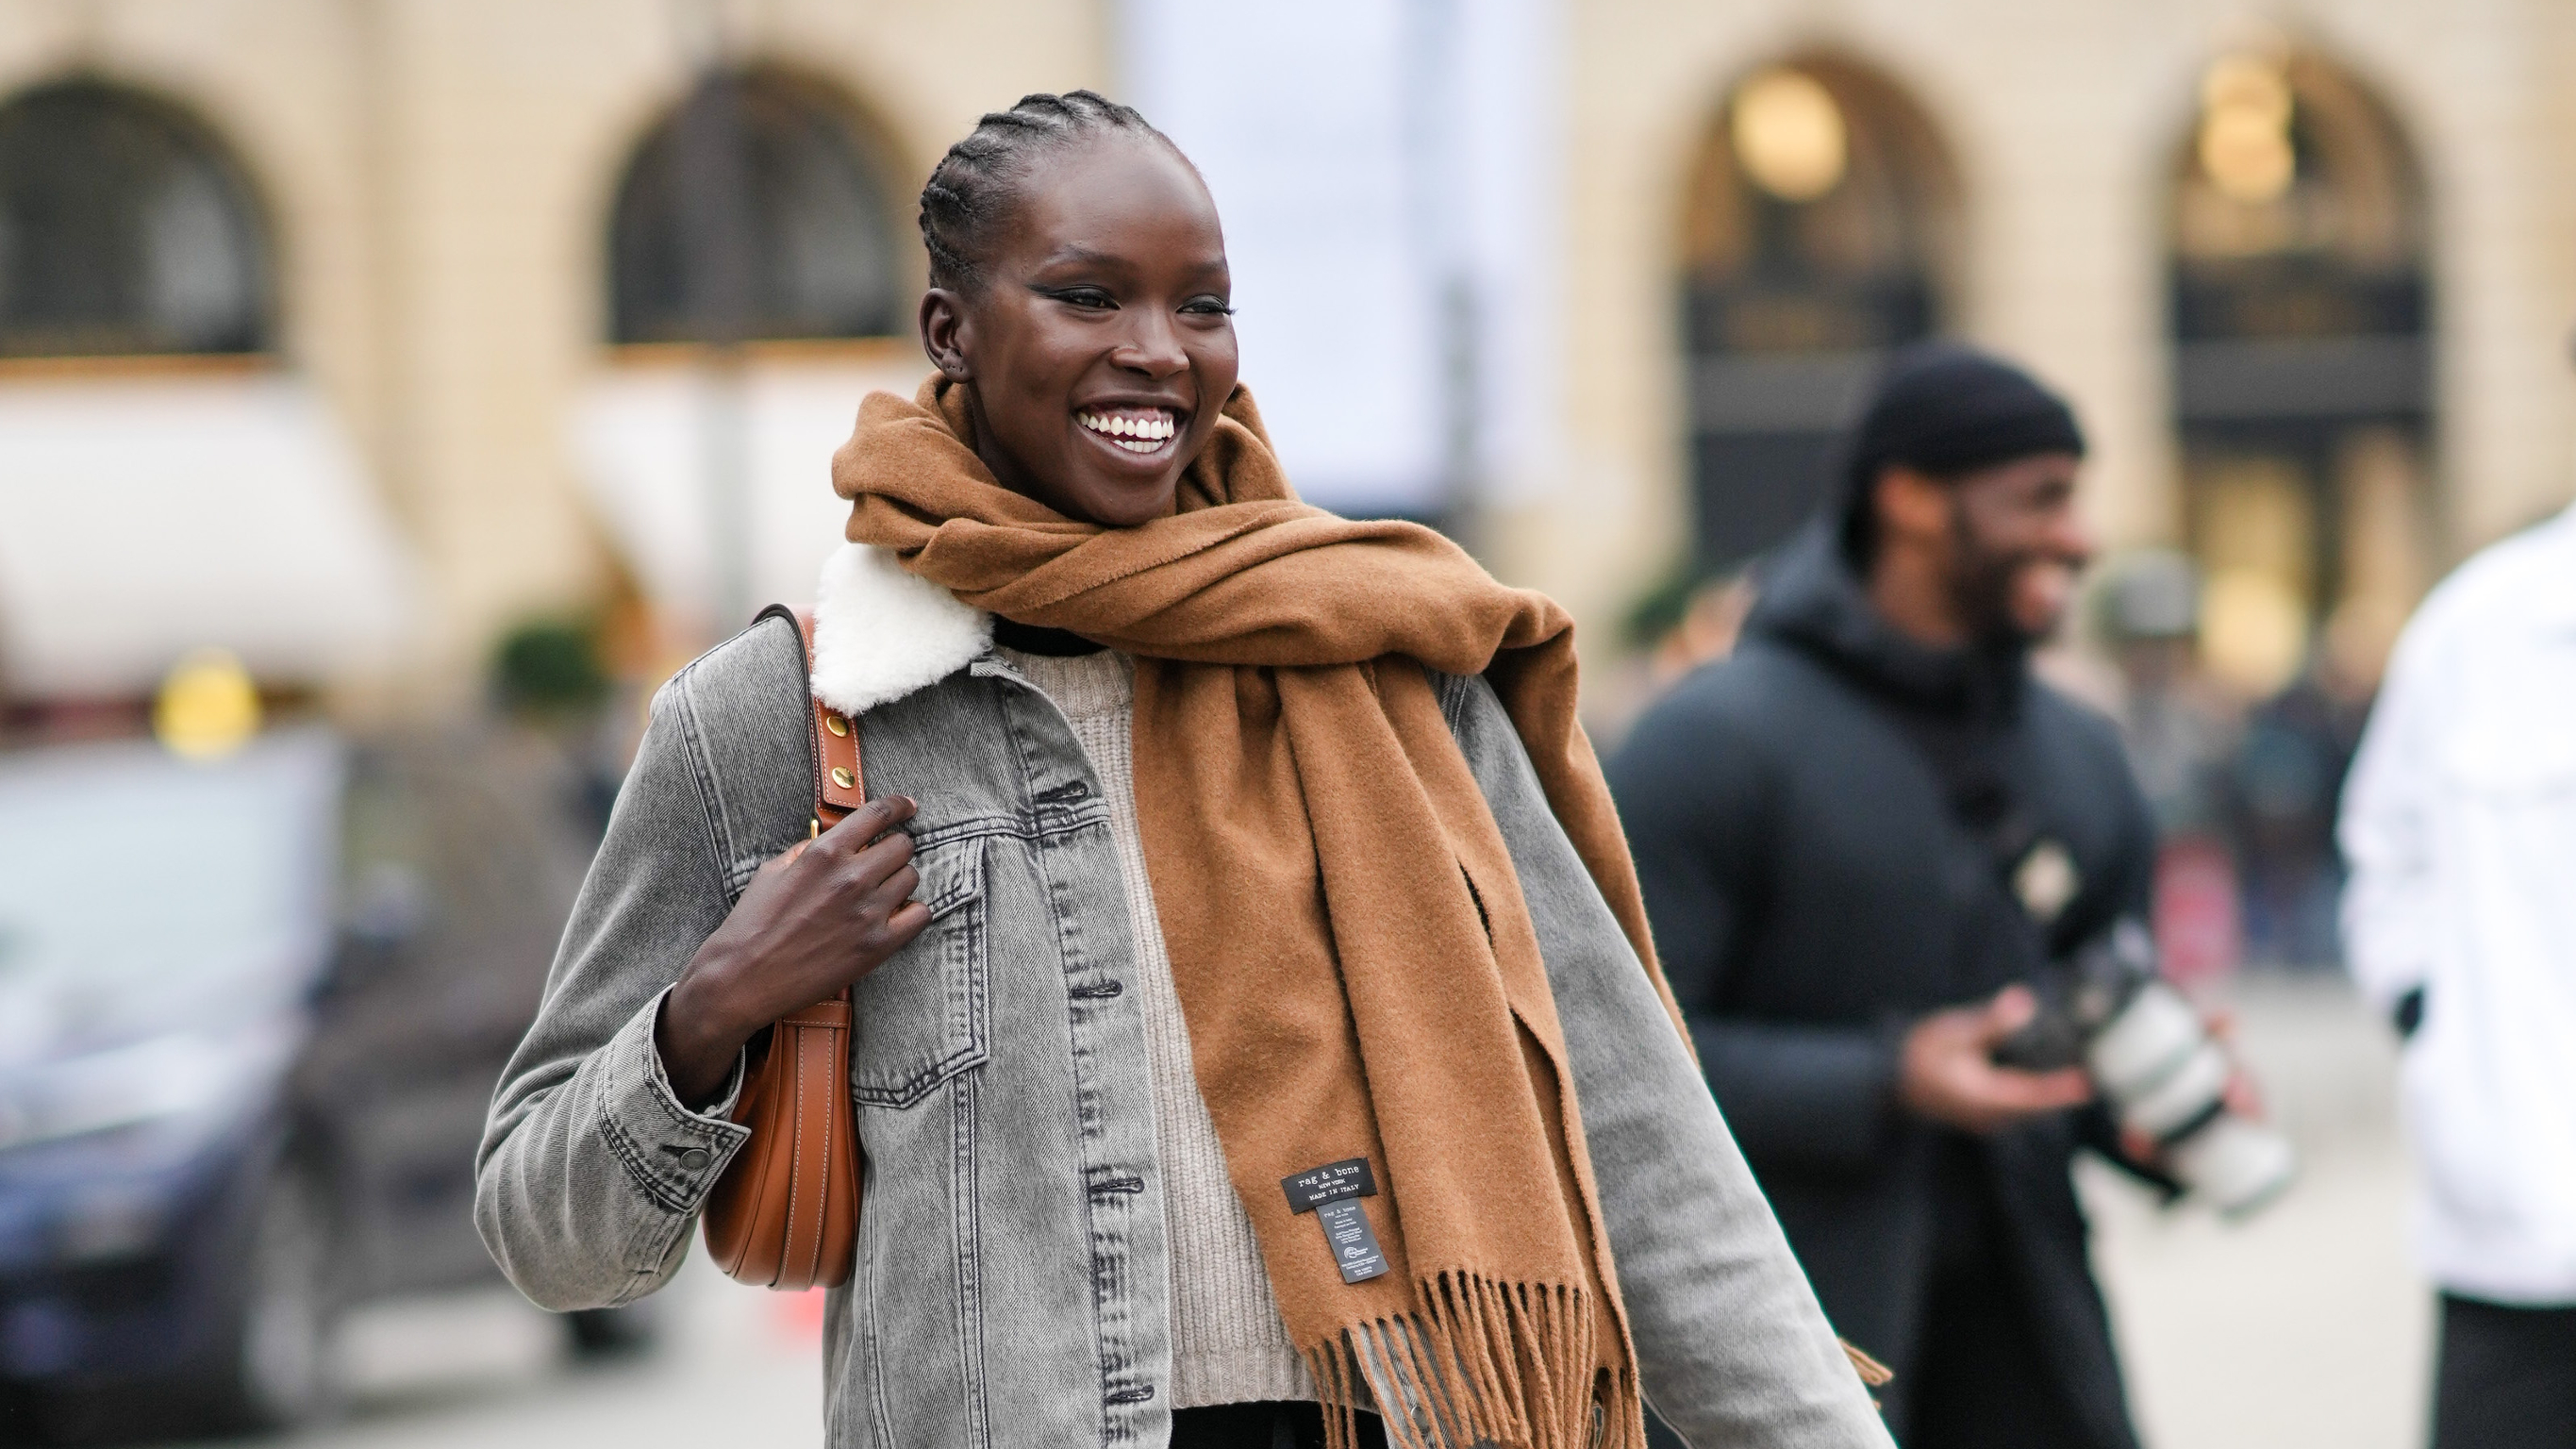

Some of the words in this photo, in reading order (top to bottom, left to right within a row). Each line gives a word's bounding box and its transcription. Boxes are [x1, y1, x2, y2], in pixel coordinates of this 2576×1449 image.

[1298, 1176, 1318, 1188] rag
[1321, 1171, 1331, 1180] &
[1335, 1166, 1359, 1176] bone
[1308, 1191, 1327, 1201] MADE
[1340, 1184, 1359, 1193] ITALY
